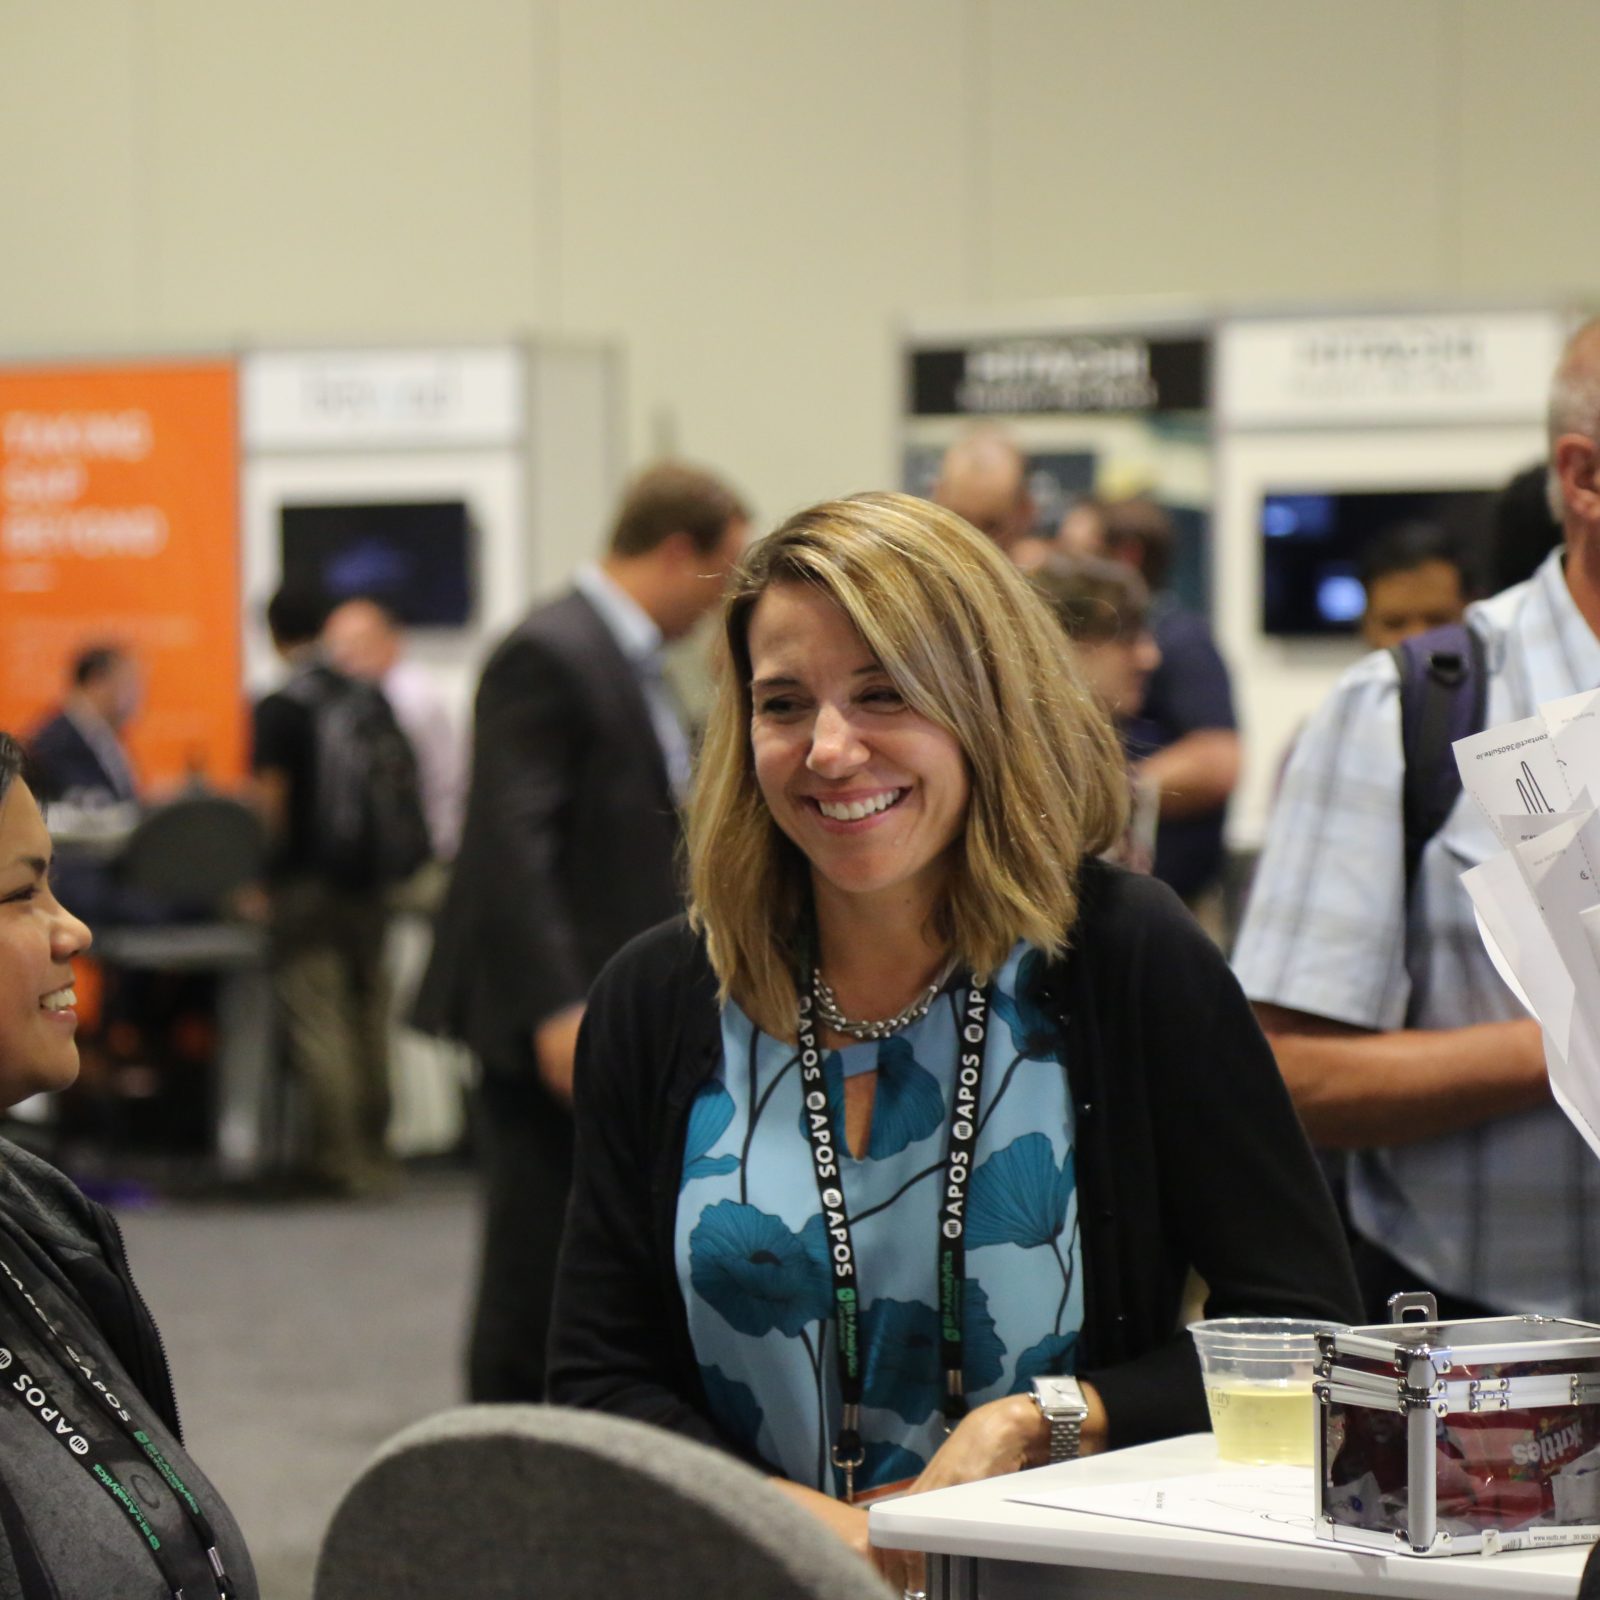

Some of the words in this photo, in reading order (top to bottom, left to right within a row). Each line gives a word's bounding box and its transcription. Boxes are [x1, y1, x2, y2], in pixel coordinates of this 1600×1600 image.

[1475, 733, 1549, 760] contact@360Suite.io
[799, 1018, 820, 1082] APOS
[956, 1054, 980, 1120] APOS
[810, 1113, 836, 1178] APOS
[946, 1151, 969, 1217] APOS
[826, 1210, 854, 1277] APOS
[13, 1374, 74, 1435] APOS
[79, 1365, 131, 1422] APOS
